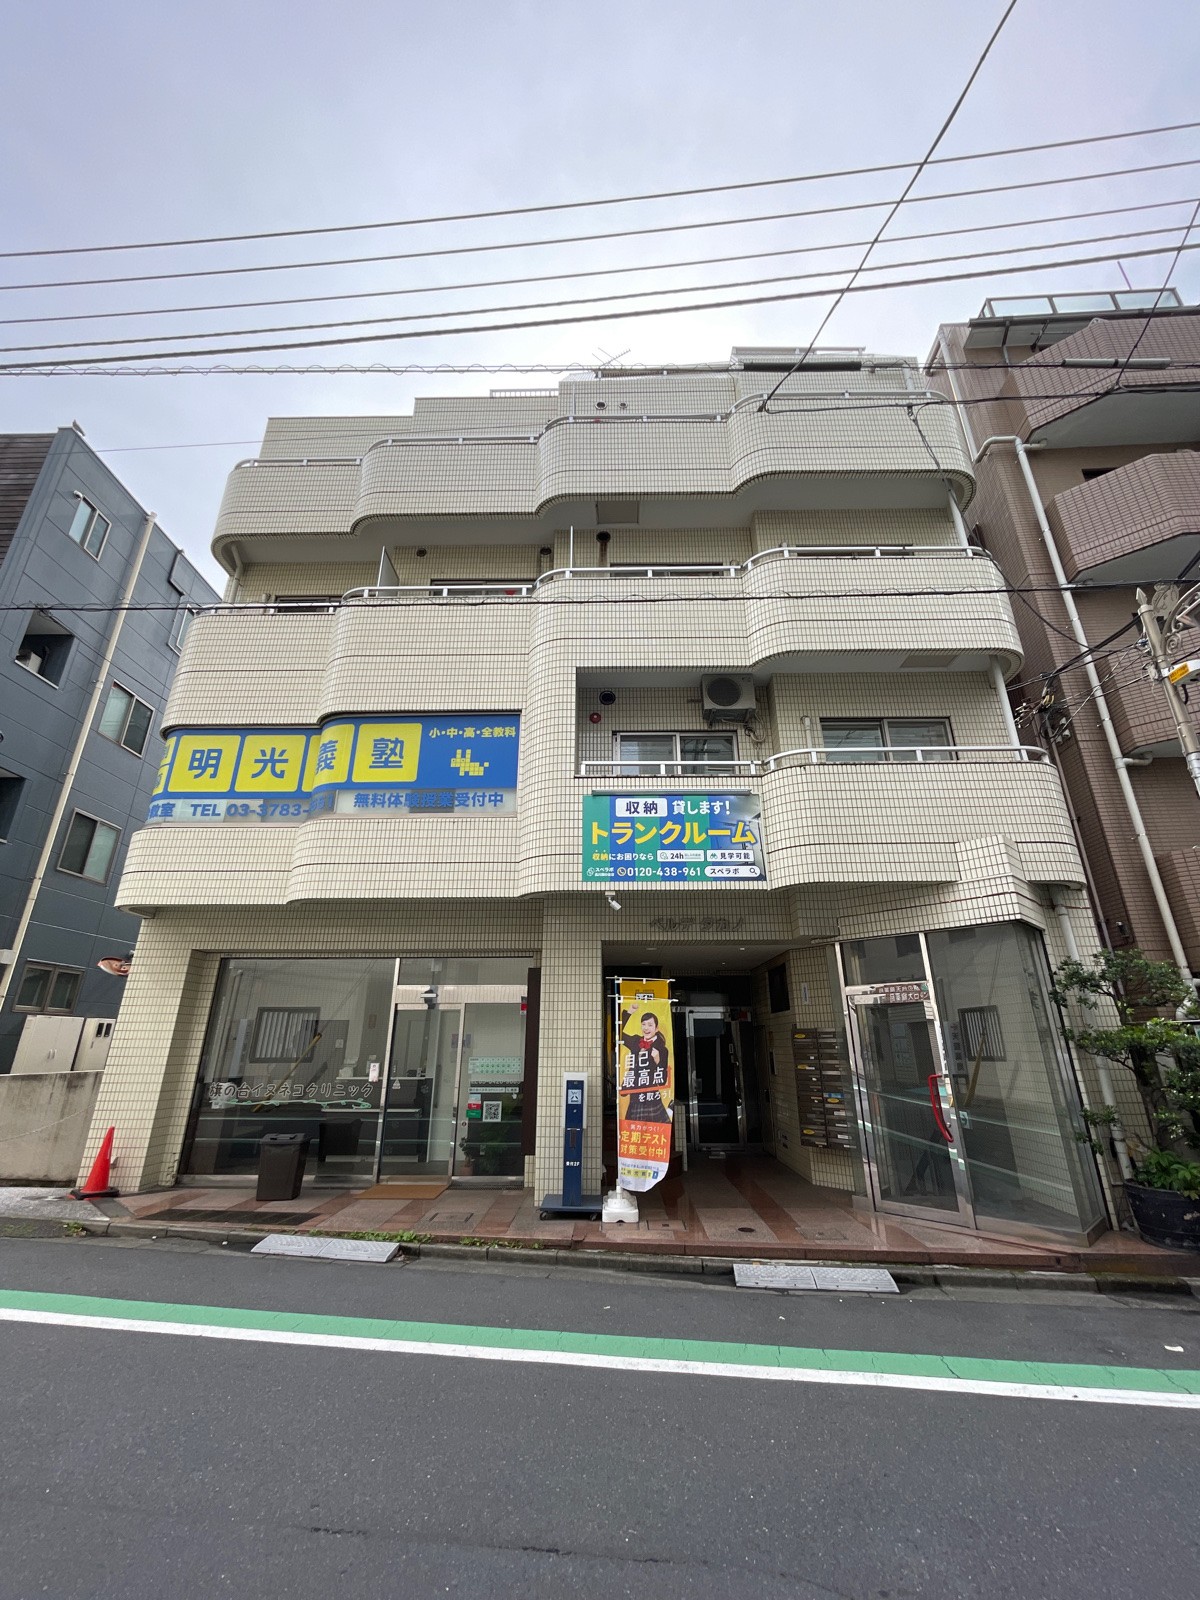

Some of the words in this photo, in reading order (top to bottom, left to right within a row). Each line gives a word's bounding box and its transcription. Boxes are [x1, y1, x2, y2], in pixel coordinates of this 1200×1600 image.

[353, 791, 504, 808] 無料体験授業受付中
[191, 804, 221, 817] TEL
[625, 801, 658, 815] 収納
[591, 820, 757, 845] トランクルーム
[592, 852, 654, 861] 収納にお困りなら
[670, 852, 684, 860] 24h
[720, 852, 751, 860] 見学可能
[627, 867, 701, 877] 0120-438-961
[625, 1051, 649, 1070] 自己
[622, 1067, 665, 1088] 最高点
[209, 1082, 374, 1098] 旗の台イヌネコクリニック
[620, 1130, 667, 1146] 定期テスト
